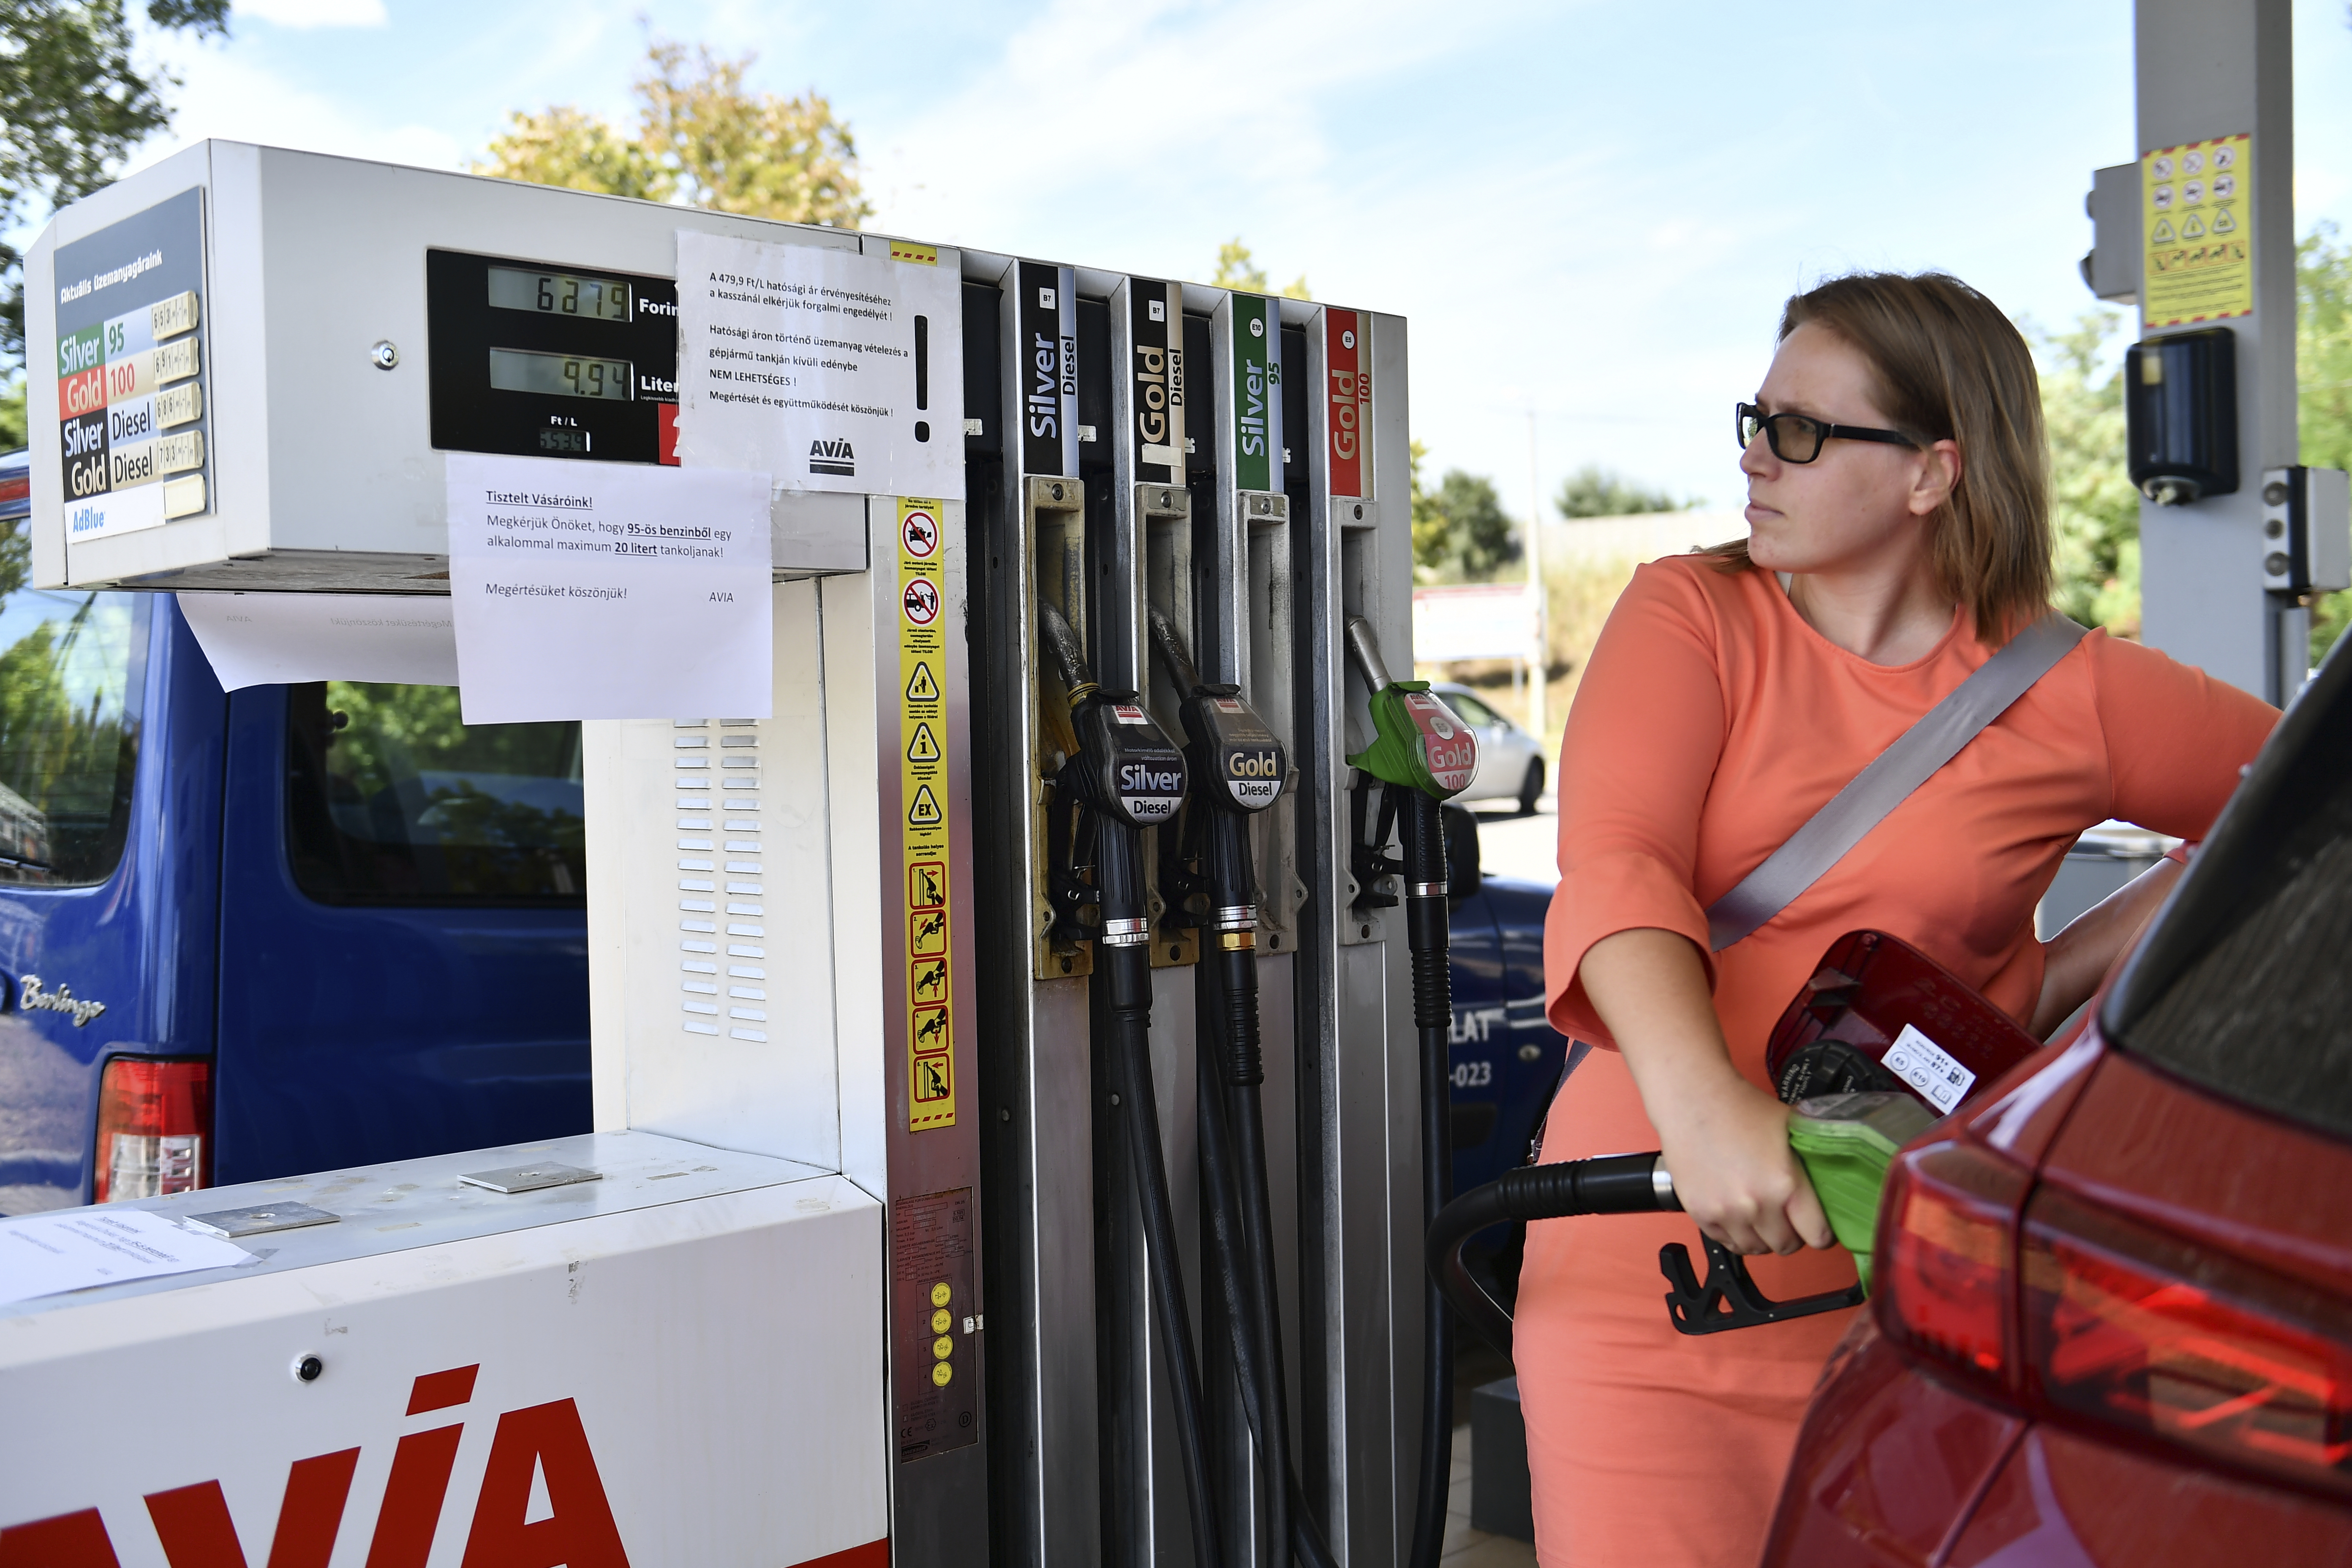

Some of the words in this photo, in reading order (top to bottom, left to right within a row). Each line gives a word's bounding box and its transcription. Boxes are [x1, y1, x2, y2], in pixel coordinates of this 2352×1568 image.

[61, 278, 92, 305] Aktuális
[94, 248, 163, 283] üzemanyagáraink
[709, 272, 717, 282] A
[719, 273, 744, 287] 479,9
[746, 277, 765, 289] Ft/L
[767, 280, 806, 296] hatósági
[808, 285, 818, 295] ár
[820, 286, 892, 307] érvényesítéséhez
[718, 288, 760, 304] kasszánál
[763, 295, 800, 309] elkérjük
[802, 299, 841, 313] forgalmi
[843, 307, 887, 321] engedélyét
[890, 312, 892, 321] !
[1043, 294, 1051, 302] B7
[1152, 307, 1160, 315] B7
[61, 335, 100, 374] Silver
[109, 322, 125, 355] 95
[710, 324, 749, 340] Hatósági
[752, 329, 773, 341] áron
[775, 332, 811, 345] történő
[814, 336, 863, 353] üzemanyag
[864, 343, 901, 357] vételezés
[709, 347, 753, 360] gépjármű
[756, 353, 790, 366] tankján
[793, 355, 818, 367] kívüli
[821, 359, 858, 372] edénybe
[1061, 335, 1075, 396] Diesel
[710, 369, 732, 380] NEM
[735, 371, 790, 386] LEHETSÉGES
[794, 377, 796, 387] !
[1029, 332, 1056, 439] Silver
[1169, 348, 1182, 406] Diesel
[1268, 362, 1280, 385] 95
[67, 369, 102, 413] Gold
[111, 363, 135, 397] 100
[1137, 344, 1166, 443] Gold
[1359, 373, 1370, 405] 100
[710, 390, 760, 404] Megértését
[762, 395, 771, 405] és
[773, 398, 849, 413] együttműködését
[851, 403, 889, 417] köszönjük
[891, 408, 893, 417] !
[1241, 359, 1265, 457] Silver
[1332, 369, 1356, 460] Gold
[65, 418, 103, 457] Silver
[112, 402, 151, 441] Diesel
[809, 438, 855, 460] AVIA
[71, 454, 106, 496] Gold
[114, 446, 153, 484] Diesel
[485, 490, 529, 504] Tisztelt
[531, 493, 592, 508] Vásáróink!
[73, 506, 104, 533] AdBlue
[487, 514, 548, 531] Megkérjük
[551, 516, 595, 533] Önöket,
[599, 520, 624, 536] hogy
[627, 523, 657, 535] 95-ös
[660, 524, 711, 538] benzinből
[714, 531, 732, 542] egy
[487, 535, 553, 549] alkalommal
[557, 540, 611, 552] maximum
[615, 542, 628, 553] 20
[631, 542, 657, 554] litert
[660, 544, 723, 559] tankoljanak!
[486, 583, 566, 597] Megértésüket
[569, 585, 627, 601] köszönjük!
[709, 592, 734, 603] AVIA
[1229, 751, 1277, 777] Gold
[1430, 742, 1472, 768] Gold
[1121, 764, 1181, 791] Silver
[1239, 782, 1273, 796] Diesel
[1445, 773, 1466, 790] 100
[918, 803, 931, 817] EX
[1133, 800, 1171, 814] Diesel
[20, 974, 106, 1027] Berlingo
[1448, 1010, 1489, 1044] LAT
[0, 1363, 630, 1568] VIA
